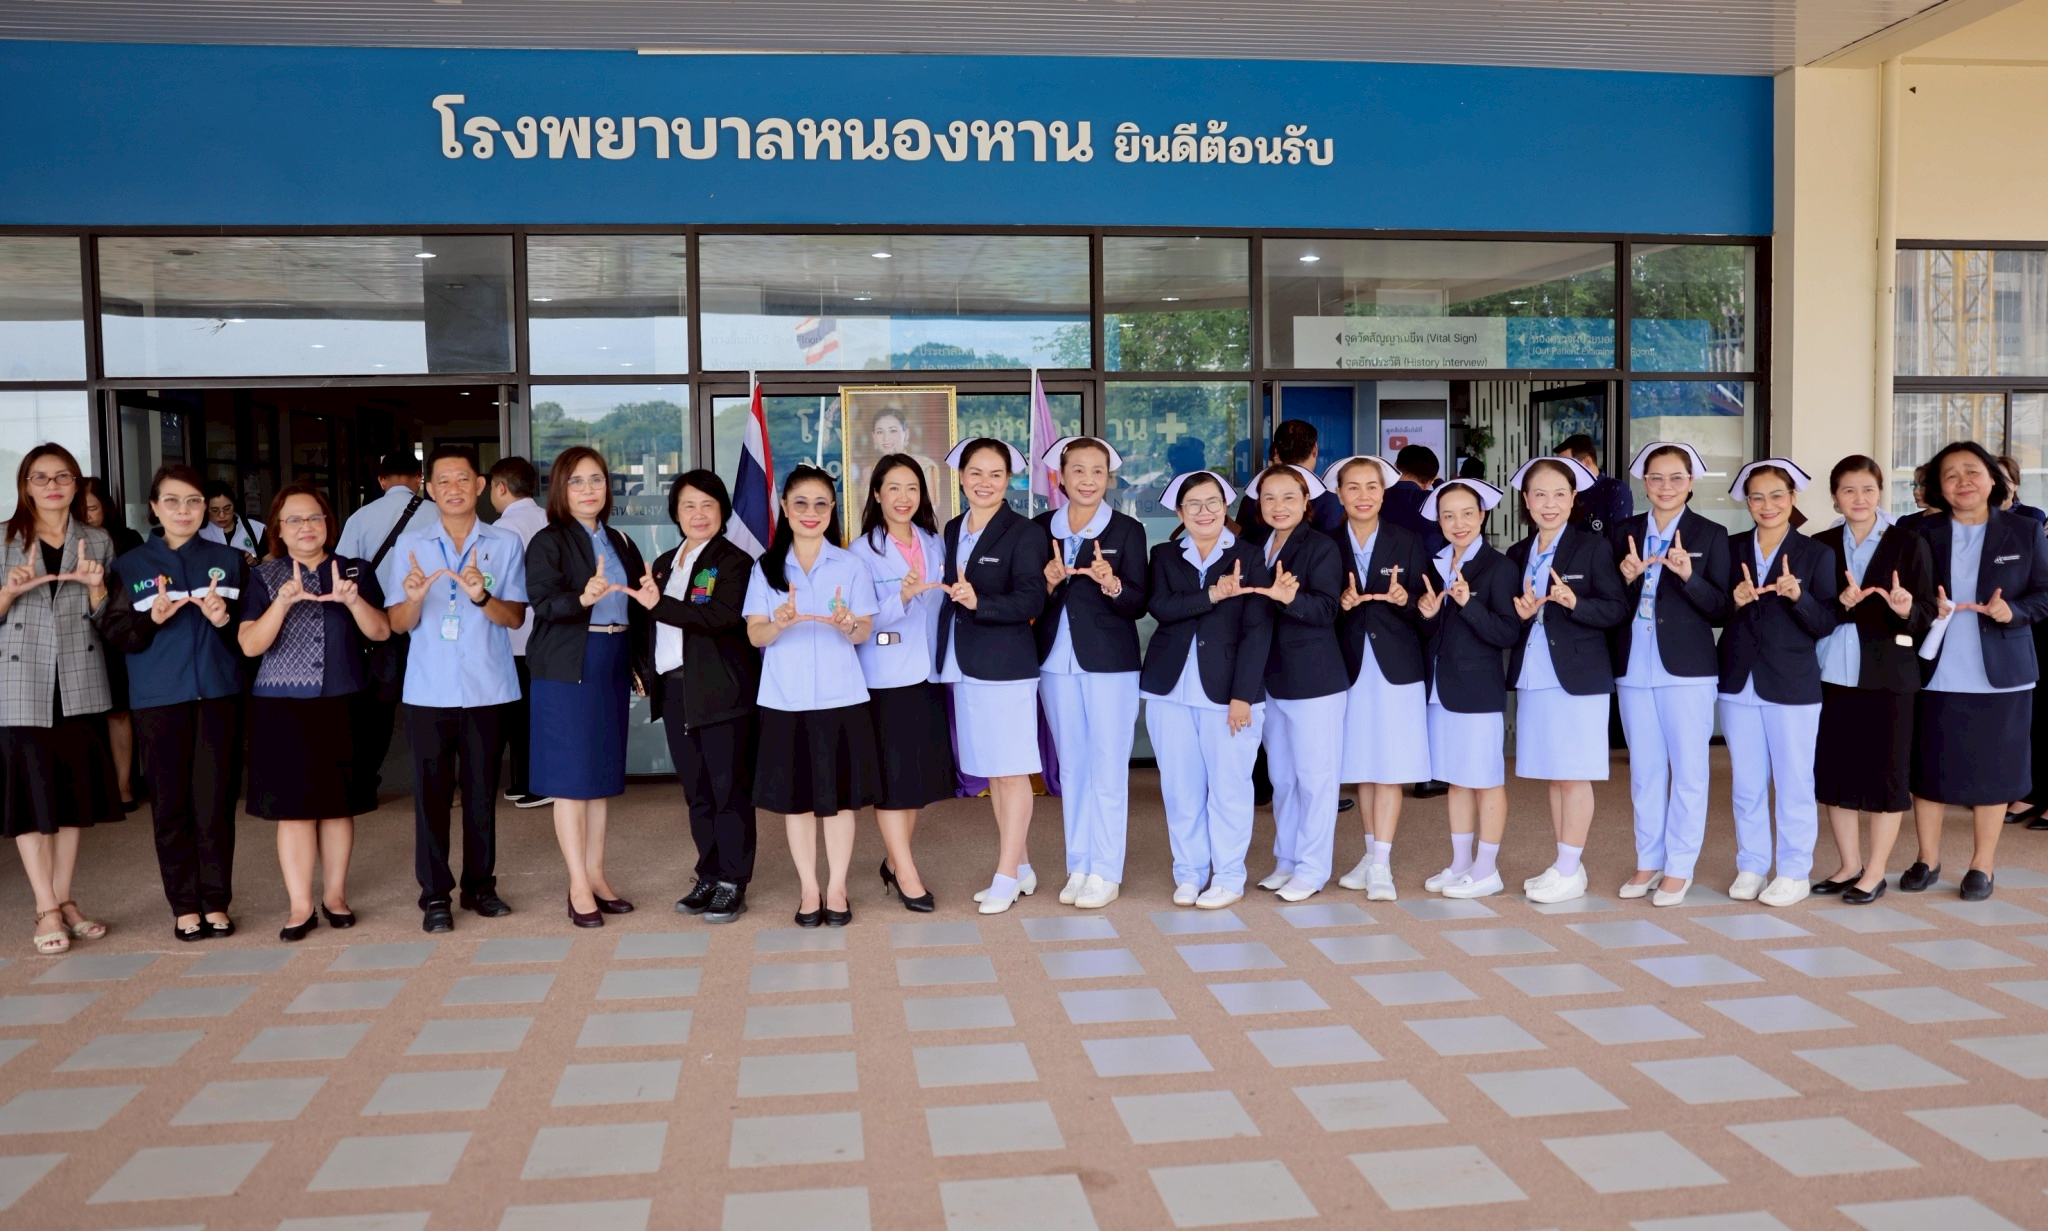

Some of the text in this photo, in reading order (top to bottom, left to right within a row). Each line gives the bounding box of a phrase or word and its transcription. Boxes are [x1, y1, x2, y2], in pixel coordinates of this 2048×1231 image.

[432, 94, 1334, 166] โรงพยาบาลหนองหาน ยินดีต้อนรับ
[1426, 333, 1451, 344] (Vital
[1453, 333, 1478, 345] Sign)
[1551, 346, 1580, 356] Patient
[1403, 357, 1440, 369] (History
[1442, 357, 1488, 368] Interview)
